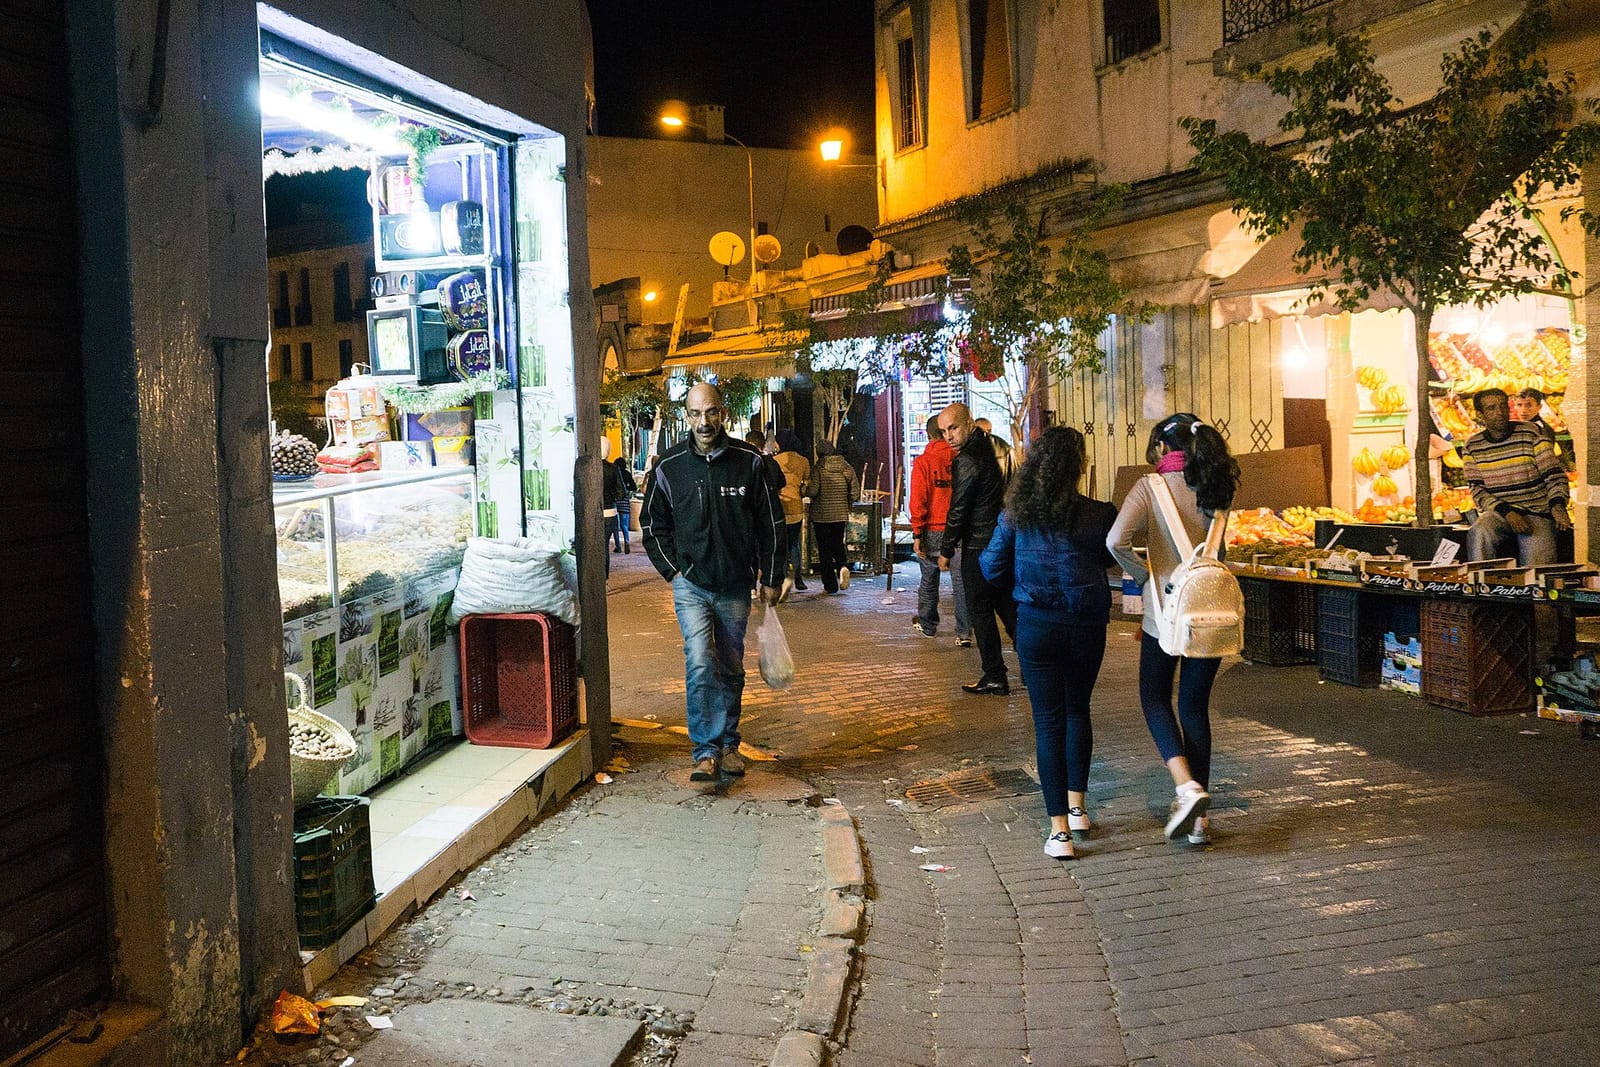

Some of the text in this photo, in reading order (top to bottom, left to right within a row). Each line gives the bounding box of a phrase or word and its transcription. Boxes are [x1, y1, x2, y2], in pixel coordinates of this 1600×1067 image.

[1369, 575, 1402, 587] Pabel
[1424, 582, 1461, 592] Pabel
[1490, 585, 1531, 596] Pabel
